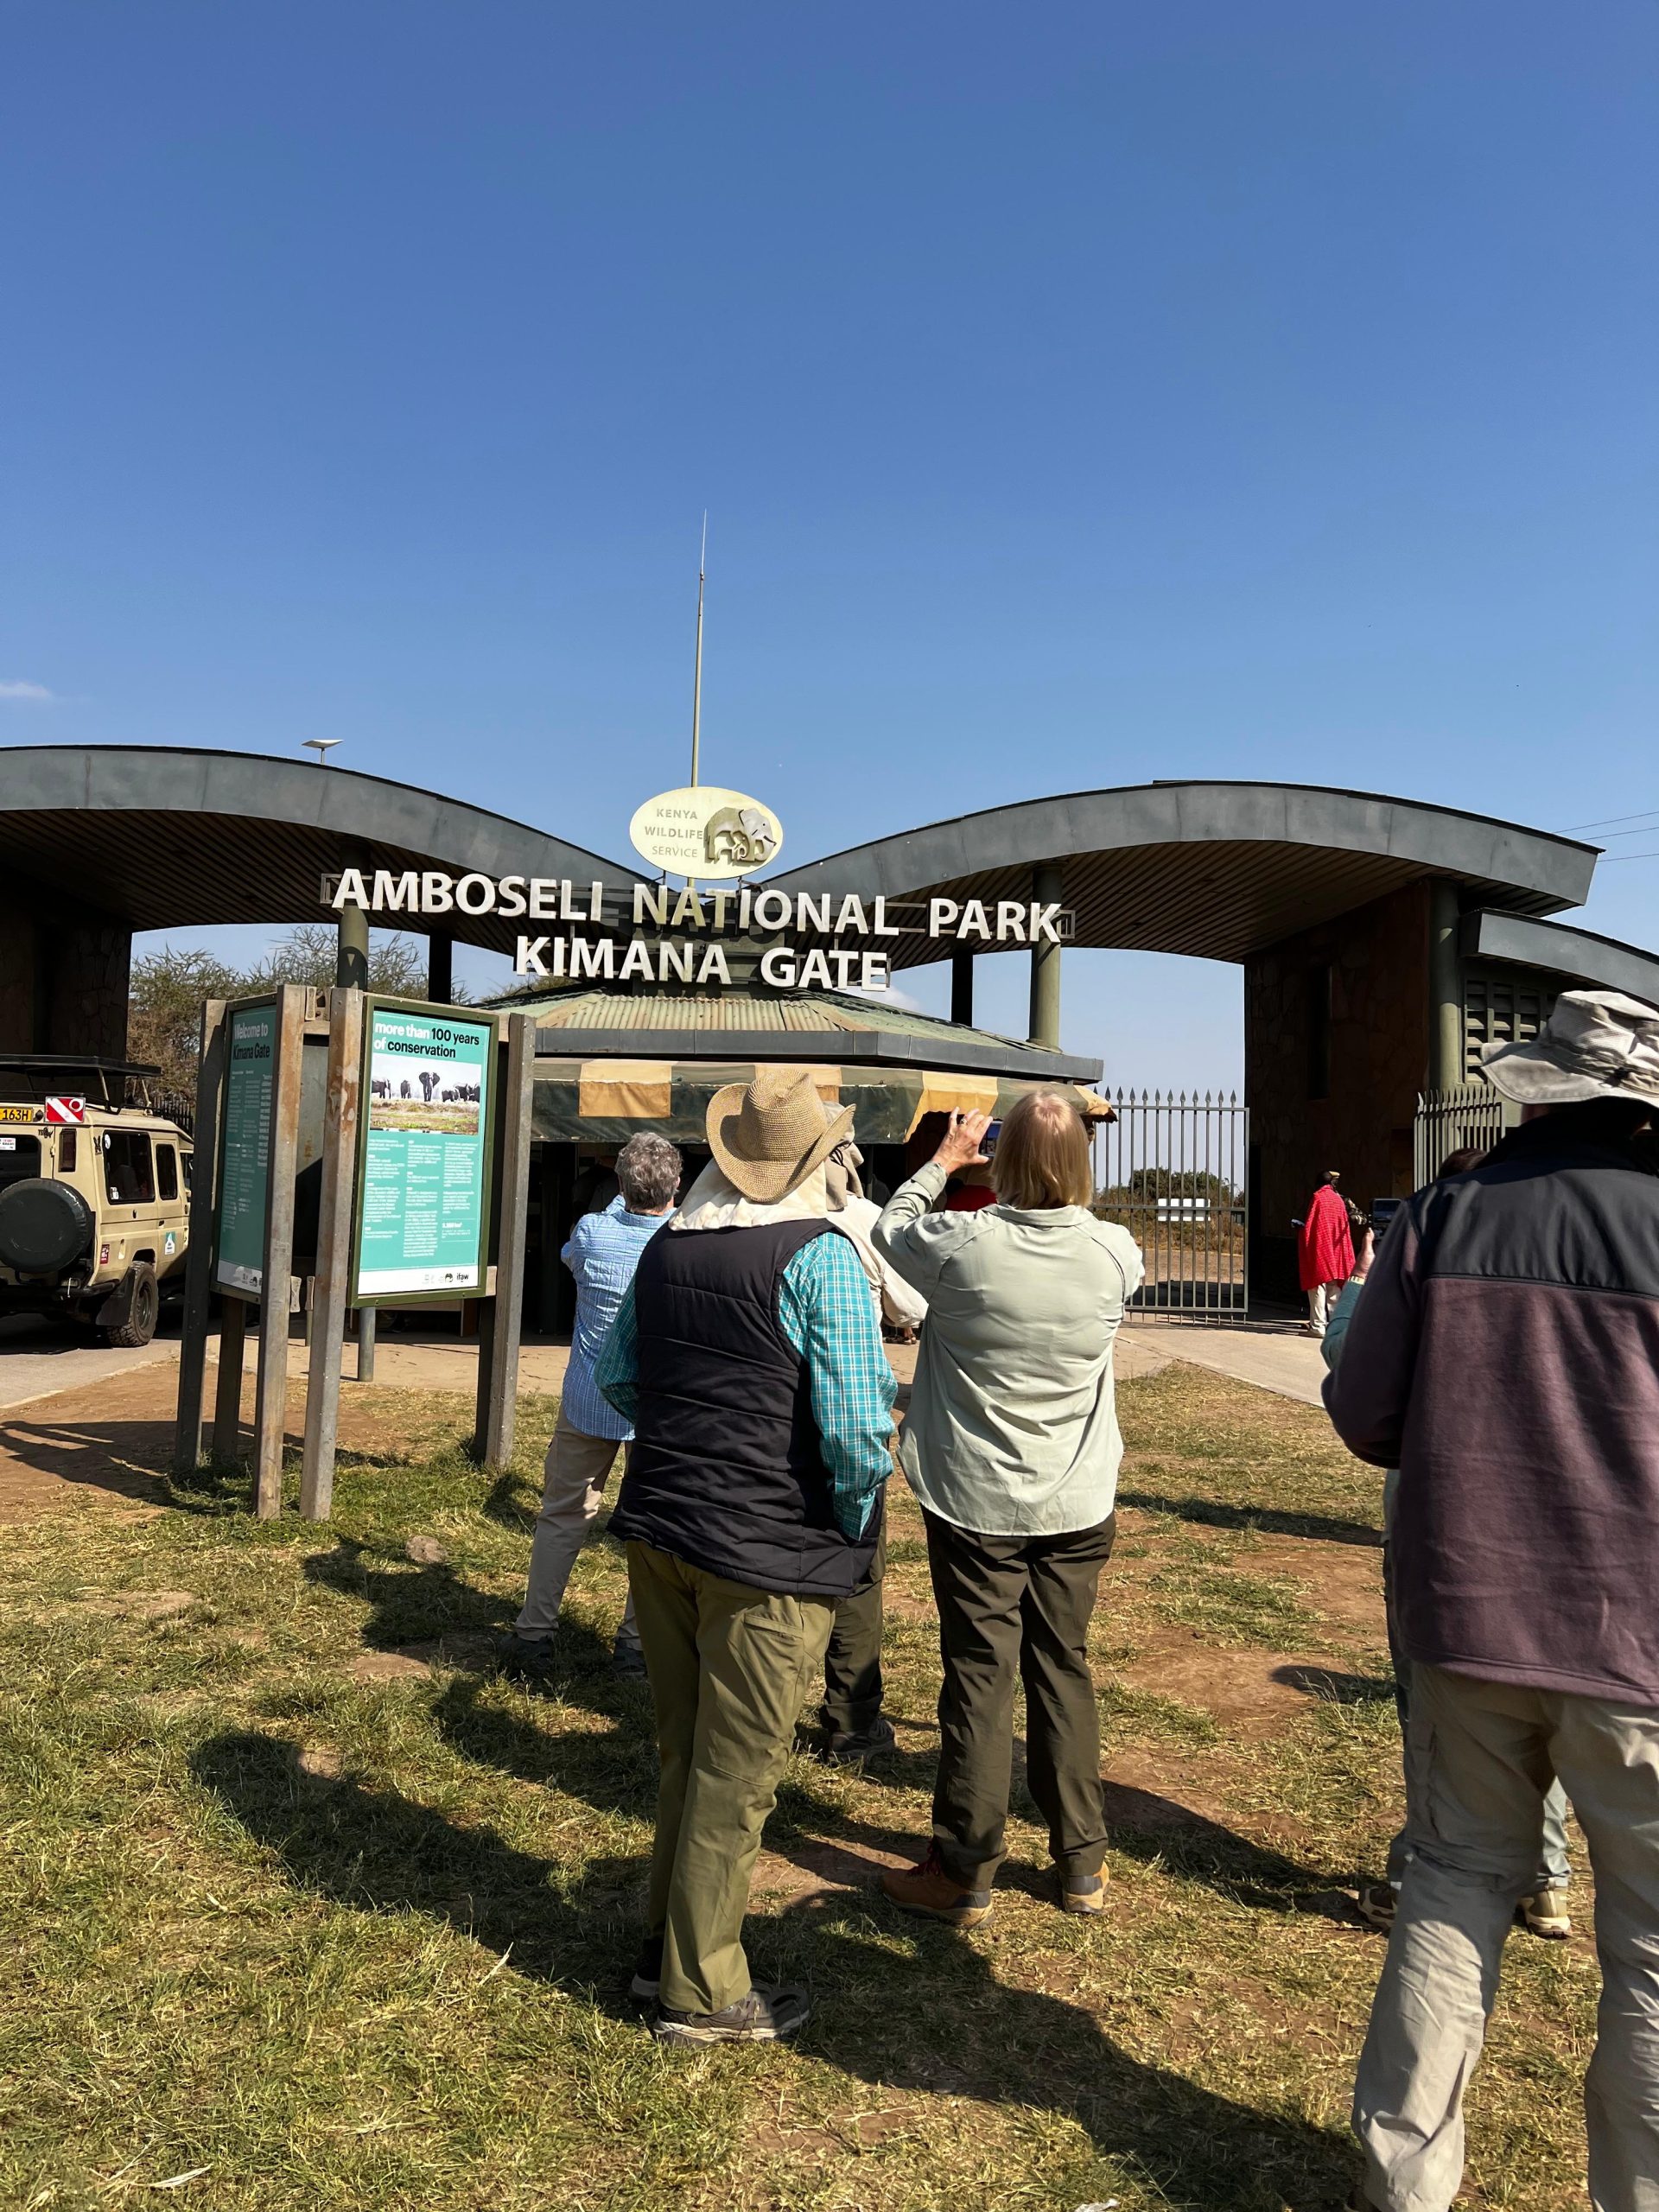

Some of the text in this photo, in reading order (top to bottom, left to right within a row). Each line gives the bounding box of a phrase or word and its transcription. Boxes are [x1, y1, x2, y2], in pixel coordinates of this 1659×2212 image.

[656, 808, 698, 821] KENYA
[644, 825, 704, 840] WILDLIFE
[652, 844, 698, 858] SERVICE
[332, 868, 1062, 943] AMBOSELI NATIONAL PARK
[516, 936, 888, 992] KIMANA GATE
[234, 1022, 268, 1039] Welcome to
[375, 1022, 480, 1045] more than 100 years
[233, 1042, 270, 1059] Kimana Gate
[374, 1037, 456, 1058] of conservation
[3, 1109, 29, 1121] 163H
